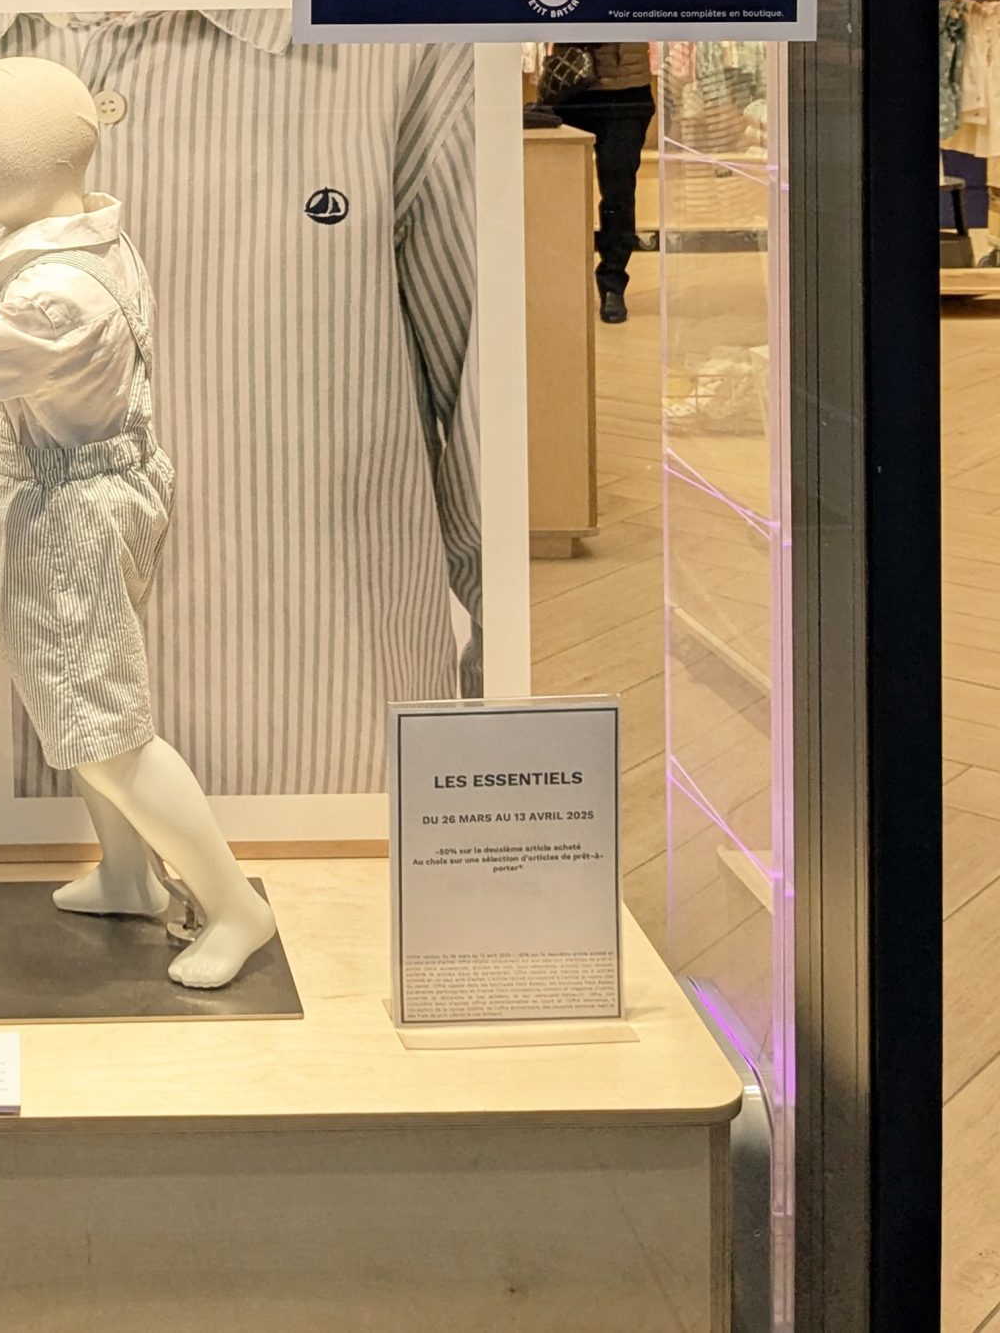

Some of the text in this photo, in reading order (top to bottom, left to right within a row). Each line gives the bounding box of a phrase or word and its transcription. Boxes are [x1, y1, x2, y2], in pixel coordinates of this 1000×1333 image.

[632, 9, 678, 18] conditions
[680, 9, 727, 19] complètes
[434, 771, 583, 789] LES ESSENTIELS
[422, 810, 595, 824] DU 26 MARS AU 13 AVRIL 2025
[473, 846, 482, 854] le
[483, 845, 523, 854] deuxième
[525, 844, 552, 853] article
[553, 843, 581, 852] acheté
[426, 857, 448, 865] choix
[481, 854, 519, 864] sélection
[560, 853, 571, 861] de
